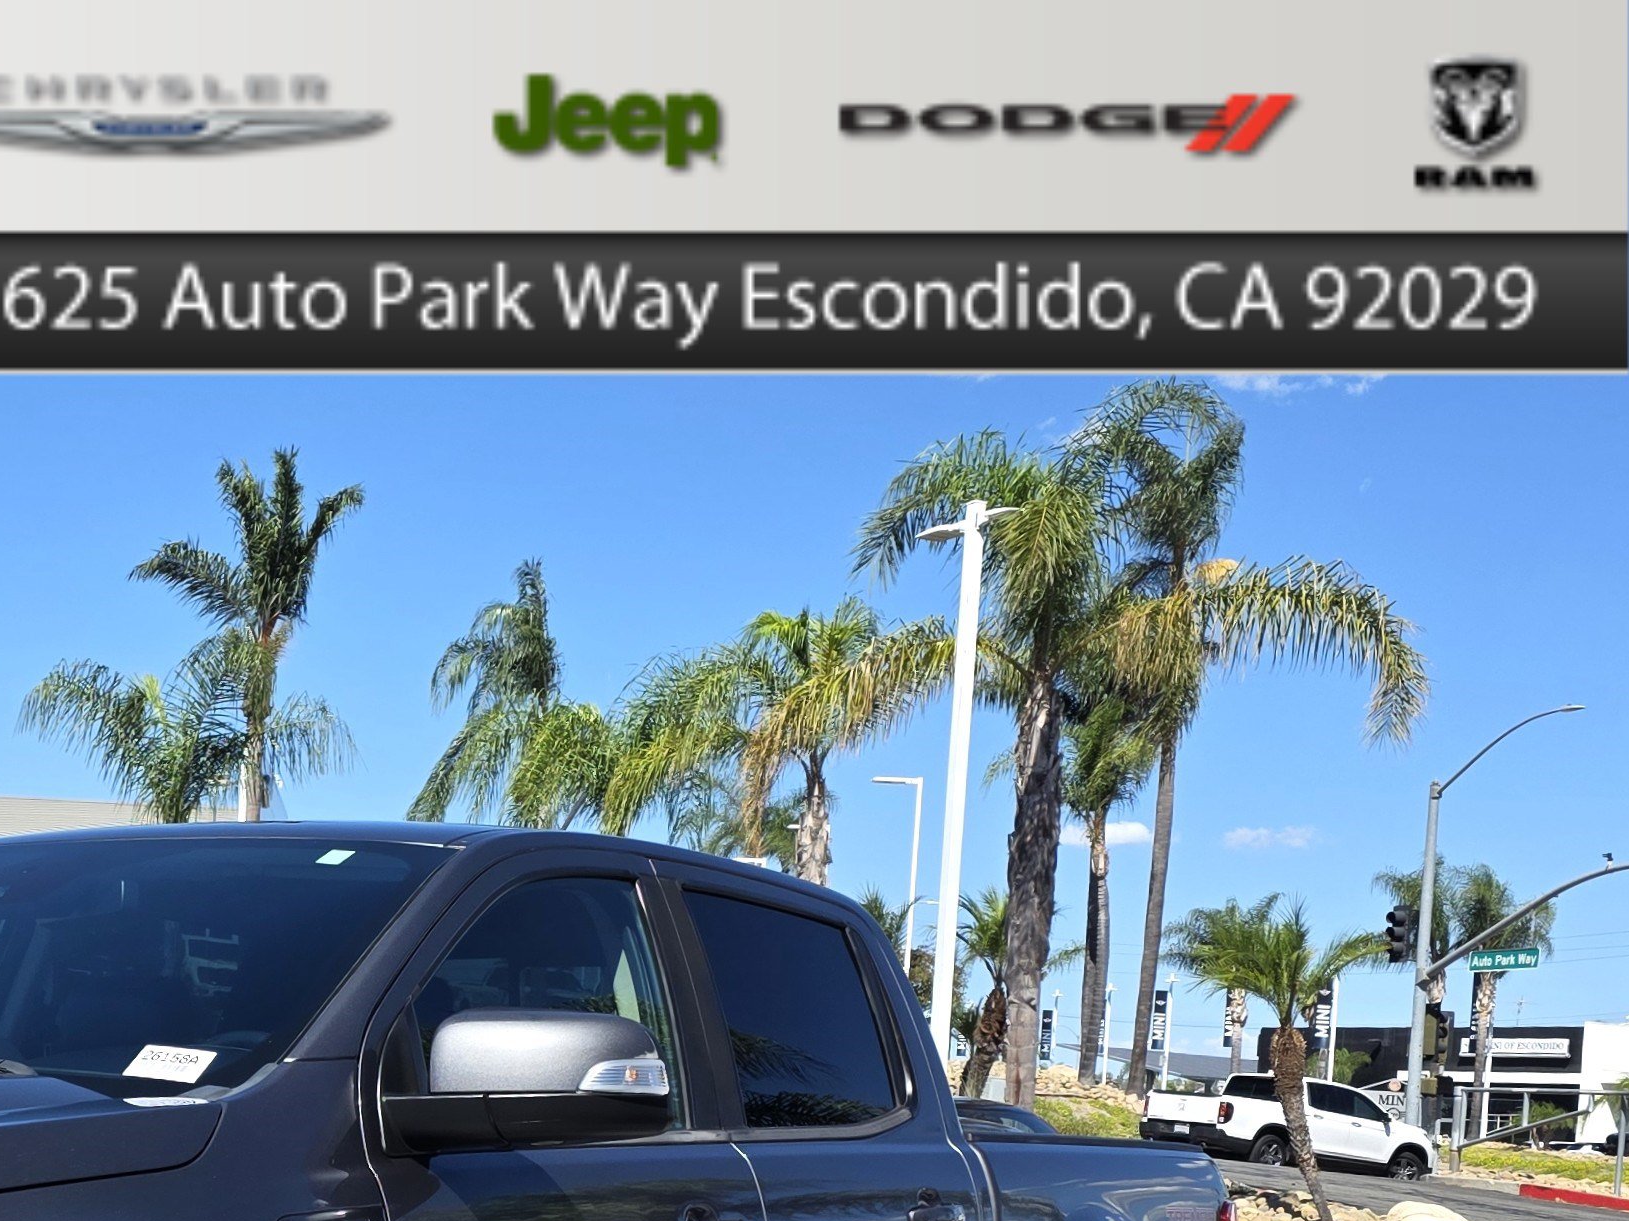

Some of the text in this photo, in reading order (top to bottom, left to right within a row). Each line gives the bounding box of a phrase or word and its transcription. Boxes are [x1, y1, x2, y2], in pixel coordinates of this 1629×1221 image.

[1472, 953, 1538, 967] Auto Park Way
[1152, 1012, 1166, 1041] MINI
[1314, 1004, 1332, 1038] MINI
[1042, 1028, 1052, 1053] MINI
[1516, 1041, 1564, 1050] ESCONDIDO
[1378, 1094, 1406, 1107] MIN
